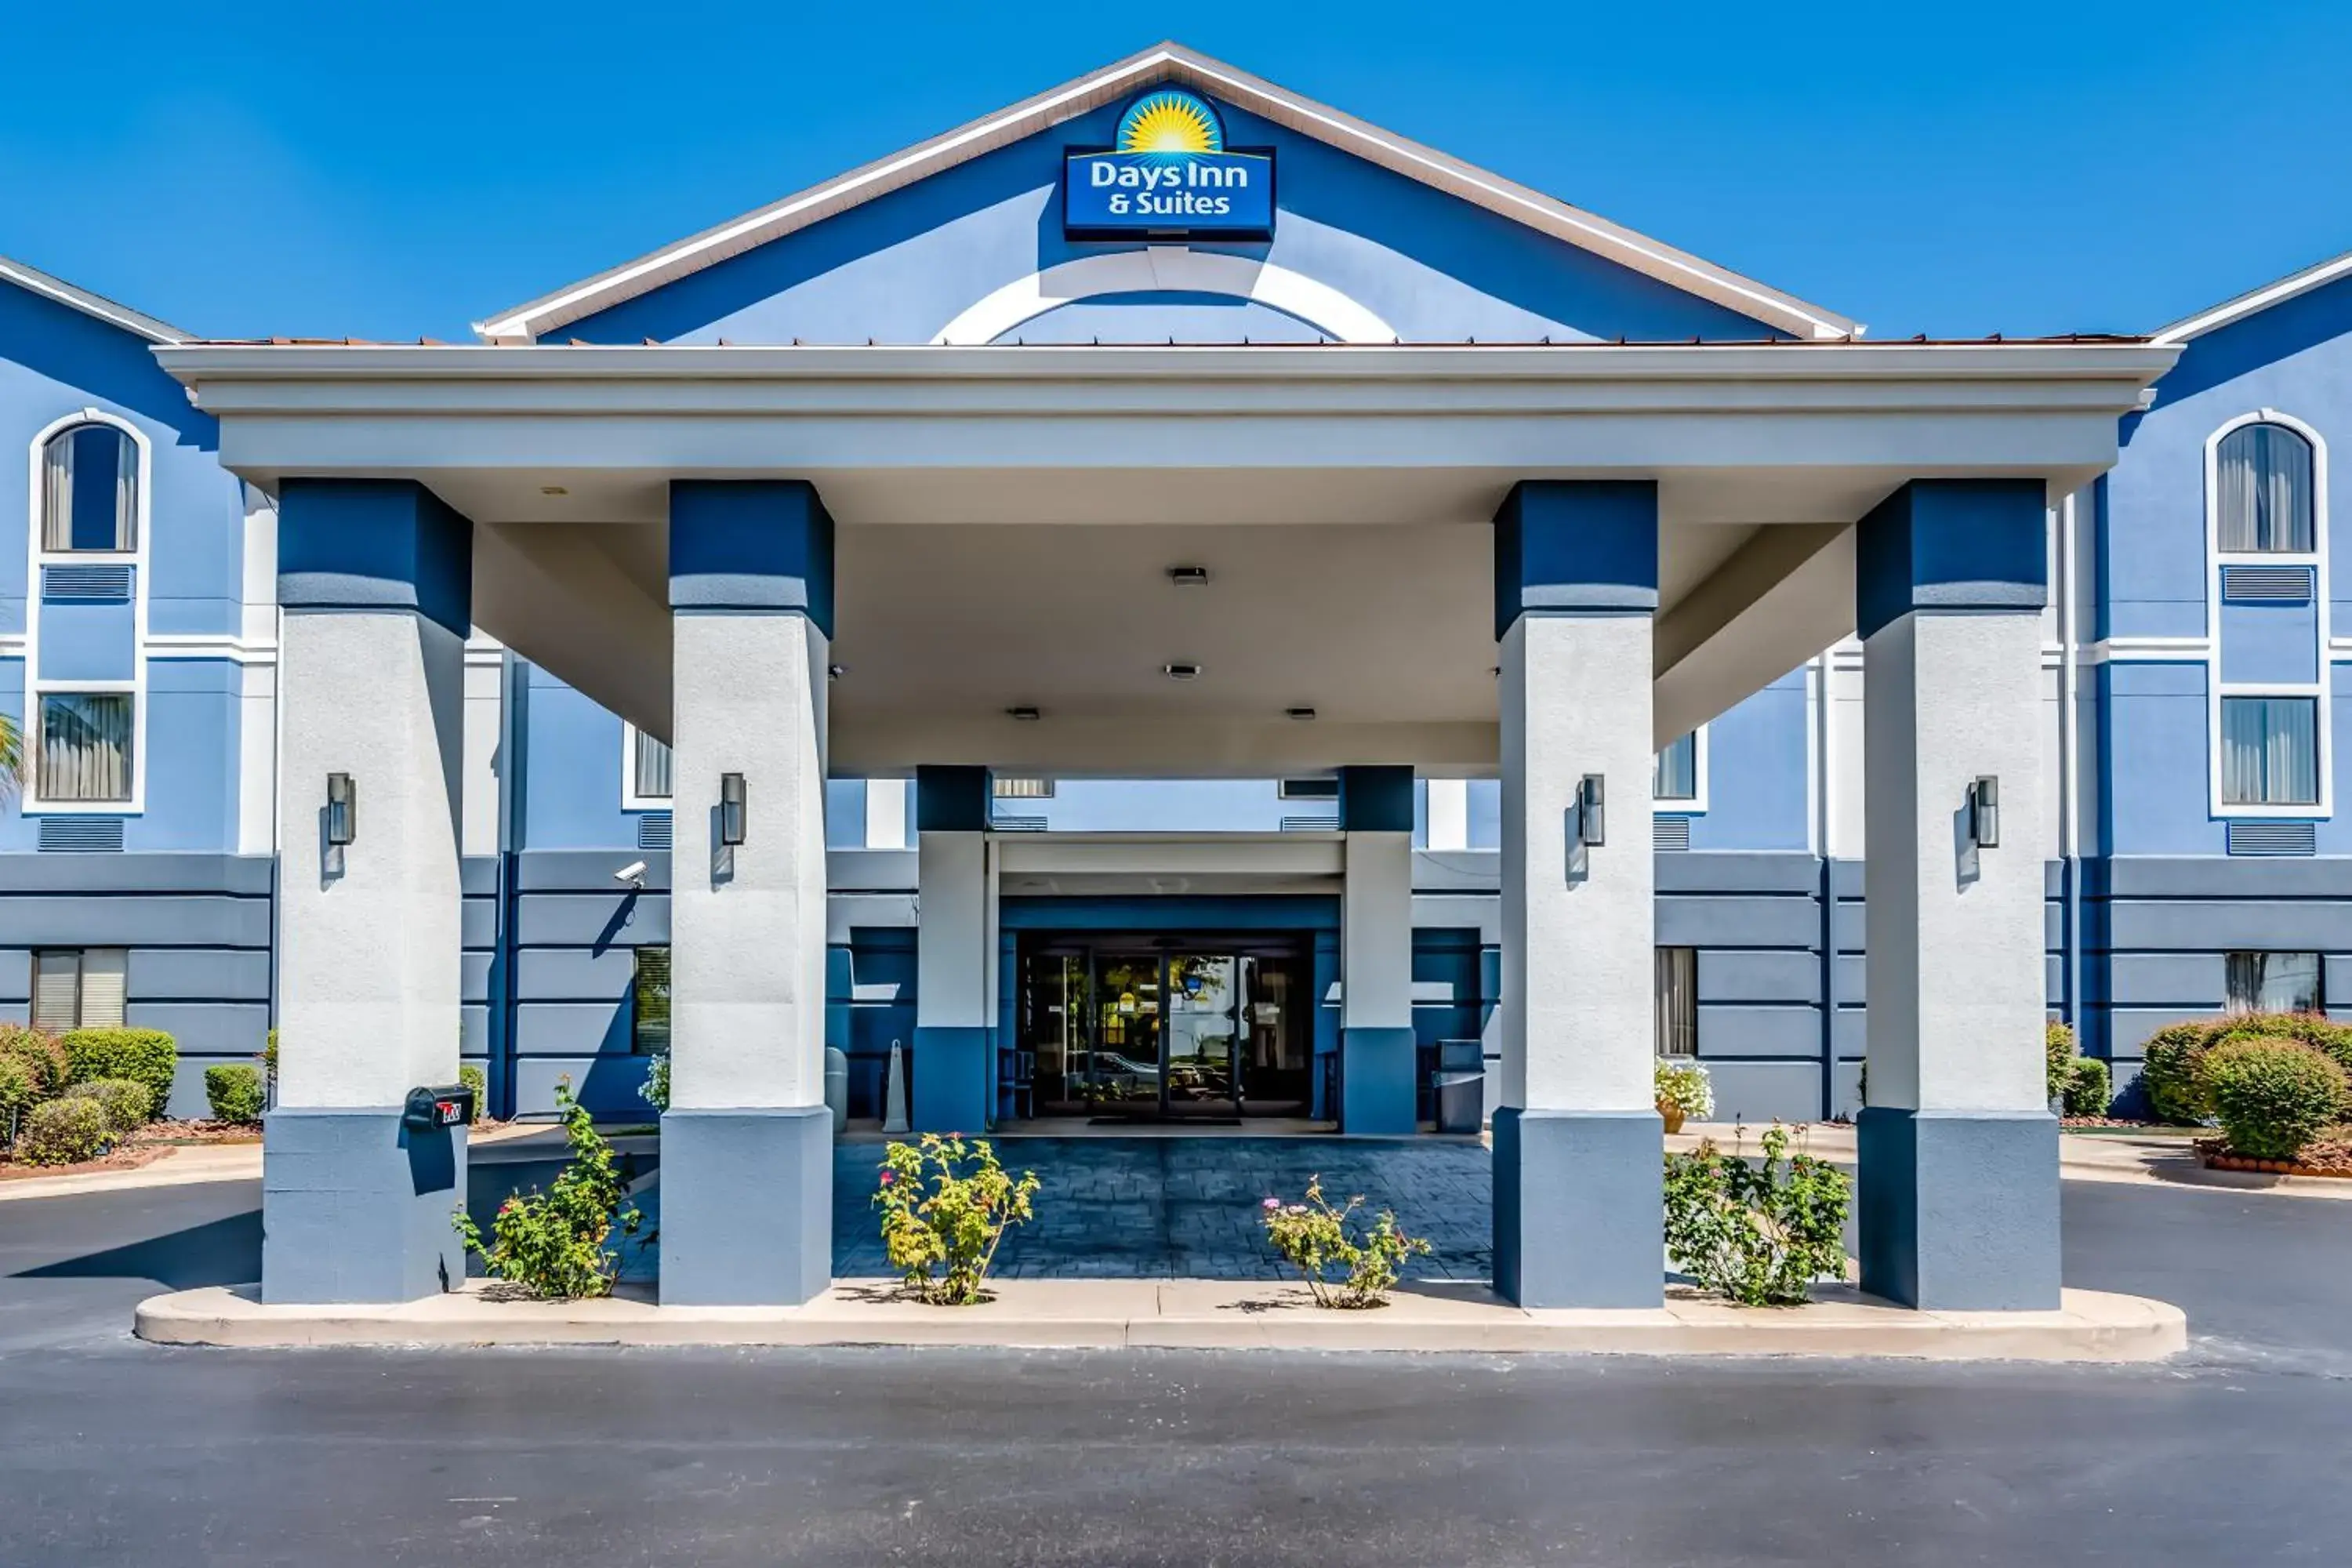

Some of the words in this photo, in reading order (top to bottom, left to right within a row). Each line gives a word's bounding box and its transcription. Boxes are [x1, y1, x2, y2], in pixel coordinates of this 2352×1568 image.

[1091, 162, 1181, 190] Days
[1189, 162, 1248, 187] Inn
[1109, 194, 1131, 214] &
[1136, 191, 1229, 214] Suites
